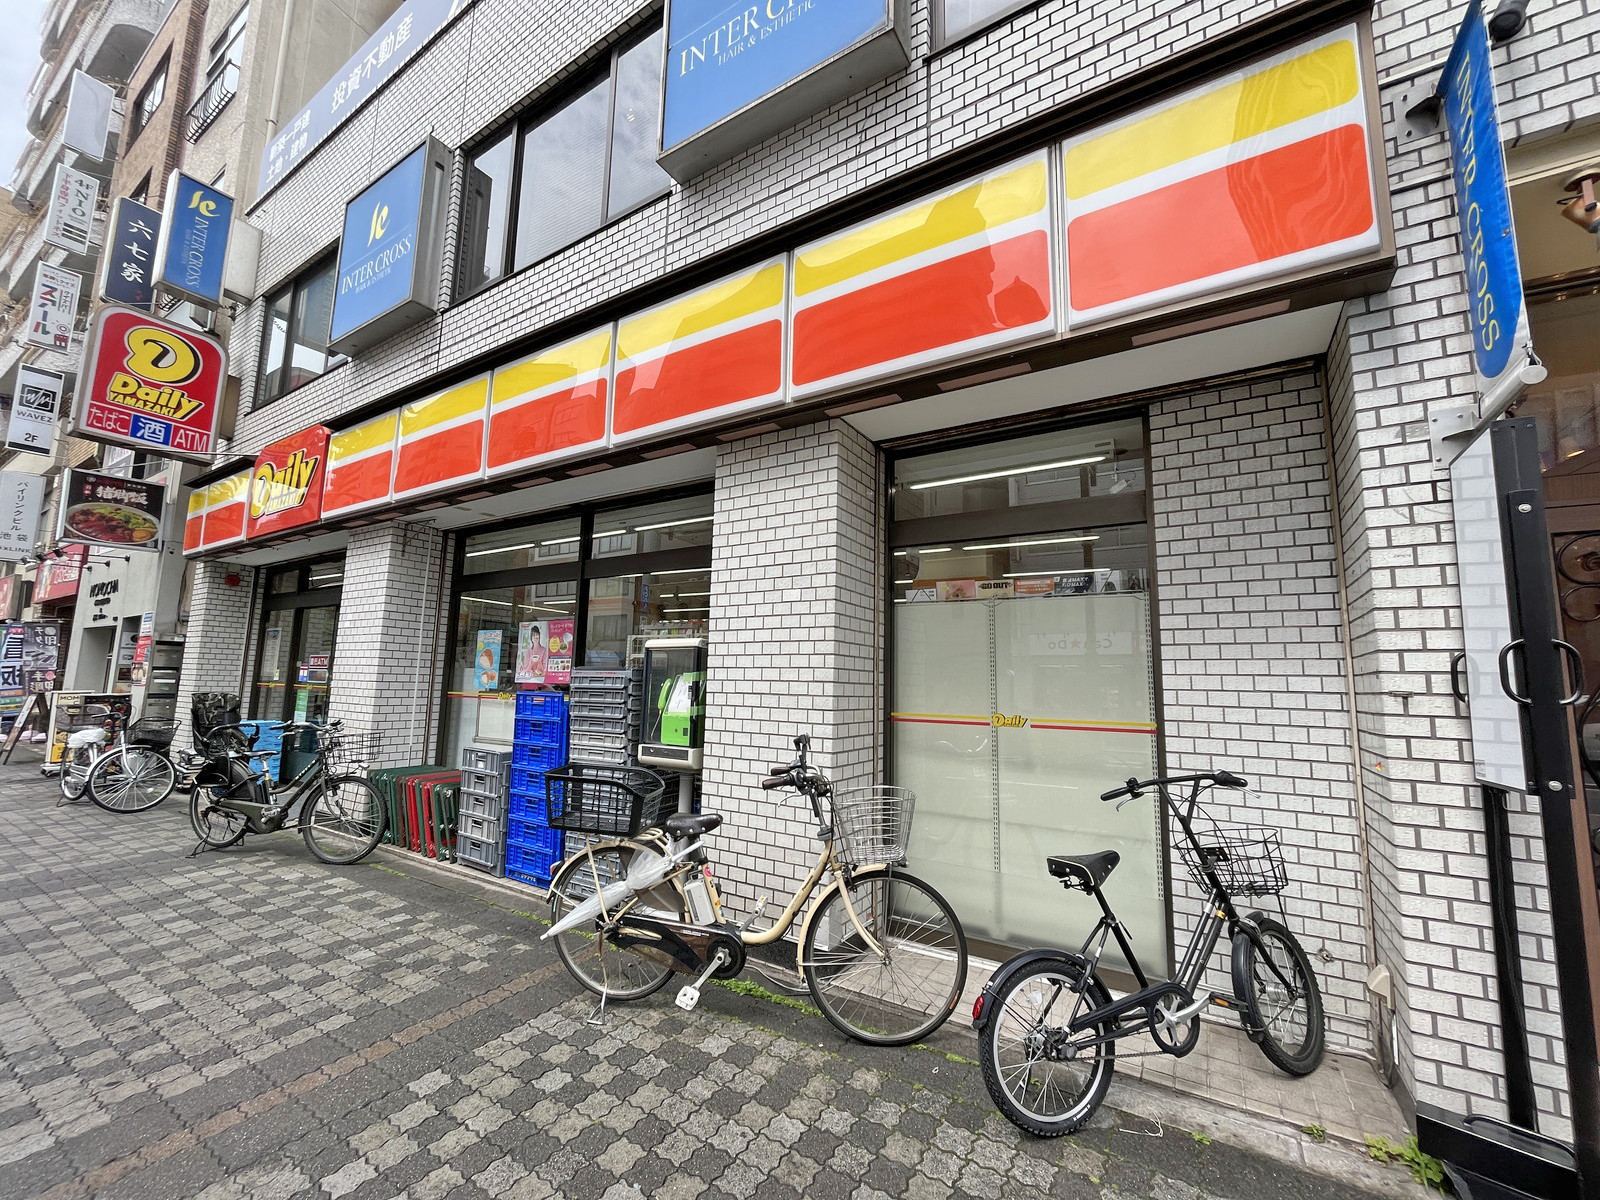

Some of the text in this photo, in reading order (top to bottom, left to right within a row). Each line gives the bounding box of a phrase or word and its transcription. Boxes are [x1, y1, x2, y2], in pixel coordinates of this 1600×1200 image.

[679, 5, 760, 77] INTER
[718, 42, 745, 66] HAIR
[747, 35, 757, 48] &
[760, 2, 816, 40] ESTHETIC
[331, 12, 413, 113] 投資不動産
[72, 188, 91, 218] NIO
[74, 178, 94, 190] 4F
[1456, 49, 1500, 351] INTER CROSS
[120, 220, 154, 284] 六七家
[190, 216, 209, 251] INTER
[185, 250, 204, 288] CROSS
[341, 233, 412, 295] INTER CROSS
[108, 391, 175, 417] YAMAZAKI
[109, 372, 204, 420] Daily
[24, 432, 39, 443] 2F
[87, 406, 208, 452] たばこ 酒 ATM
[250, 449, 319, 519] Daily
[0, 531, 28, 542] 池袋
[993, 581, 1008, 589] OUT
[991, 712, 1029, 728] Daily
